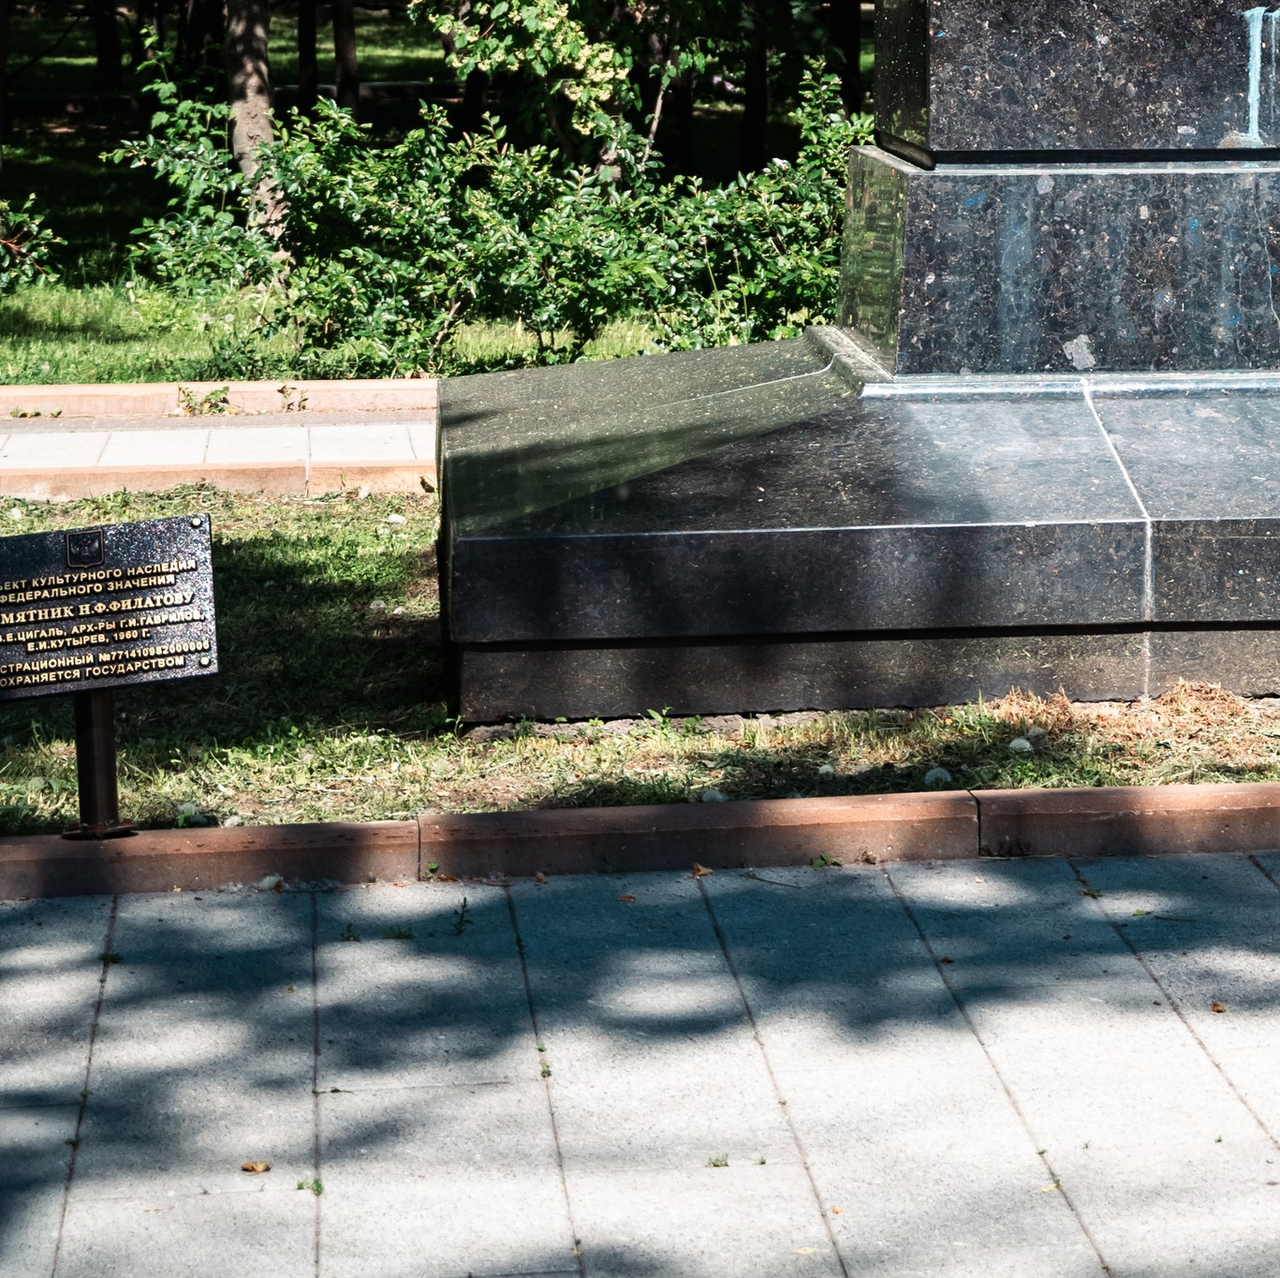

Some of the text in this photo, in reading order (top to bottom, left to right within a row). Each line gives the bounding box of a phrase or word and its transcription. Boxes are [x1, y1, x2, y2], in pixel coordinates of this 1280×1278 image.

[32, 568, 123, 588] КУЛЬТУРНОГО
[127, 559, 196, 577] НАСЛЕДИЯ
[0, 574, 176, 604] ФЕДЕРАЛЬНОГО ЗНАЧЕНИЯ
[71, 621, 116, 635] АРХ-РЫ
[113, 629, 138, 641] 1960
[141, 628, 151, 638] Г.
[0, 655, 184, 687] ОХРАНЯЕТСЯ ГОСУДАРСТВОМ
